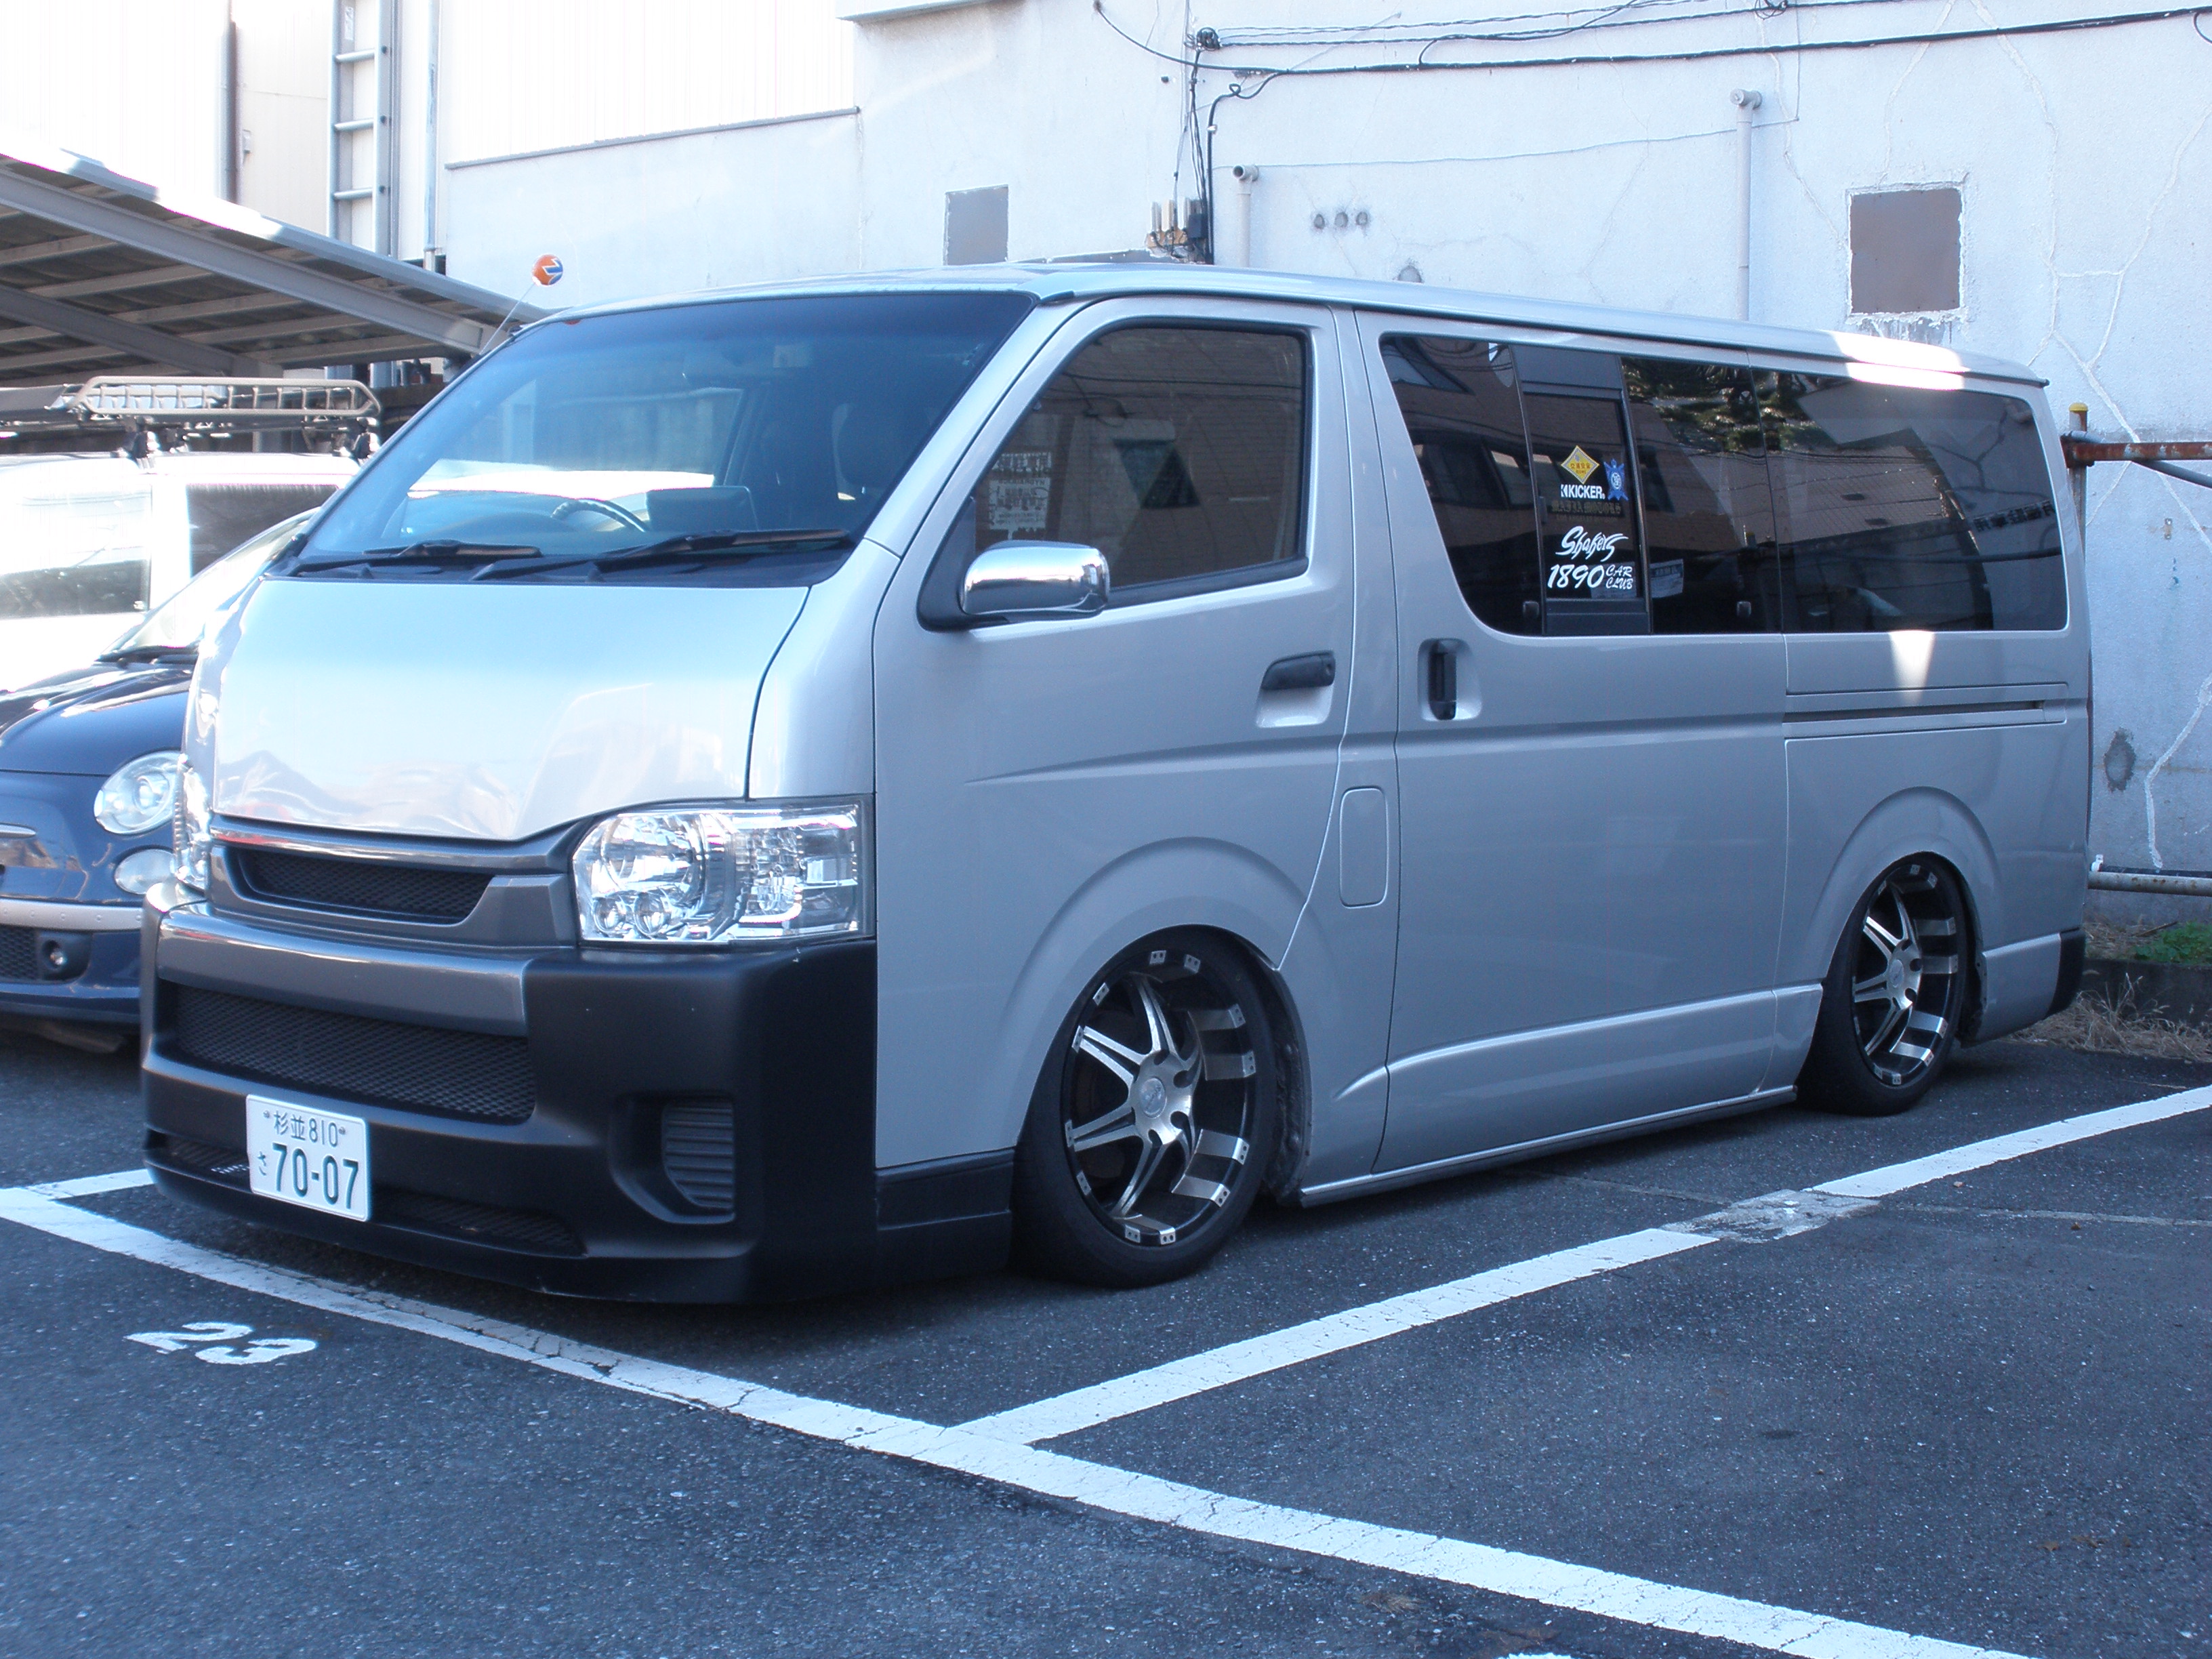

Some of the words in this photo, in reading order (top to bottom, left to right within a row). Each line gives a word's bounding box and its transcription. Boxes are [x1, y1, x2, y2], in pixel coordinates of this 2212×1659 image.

[1555, 526, 1629, 562] Shakers
[1547, 564, 1605, 588] 1890
[1605, 565, 1633, 577] CAR
[1605, 577, 1633, 590] CLUB
[257, 1151, 266, 1176] さ
[272, 1142, 359, 1210] 70-07
